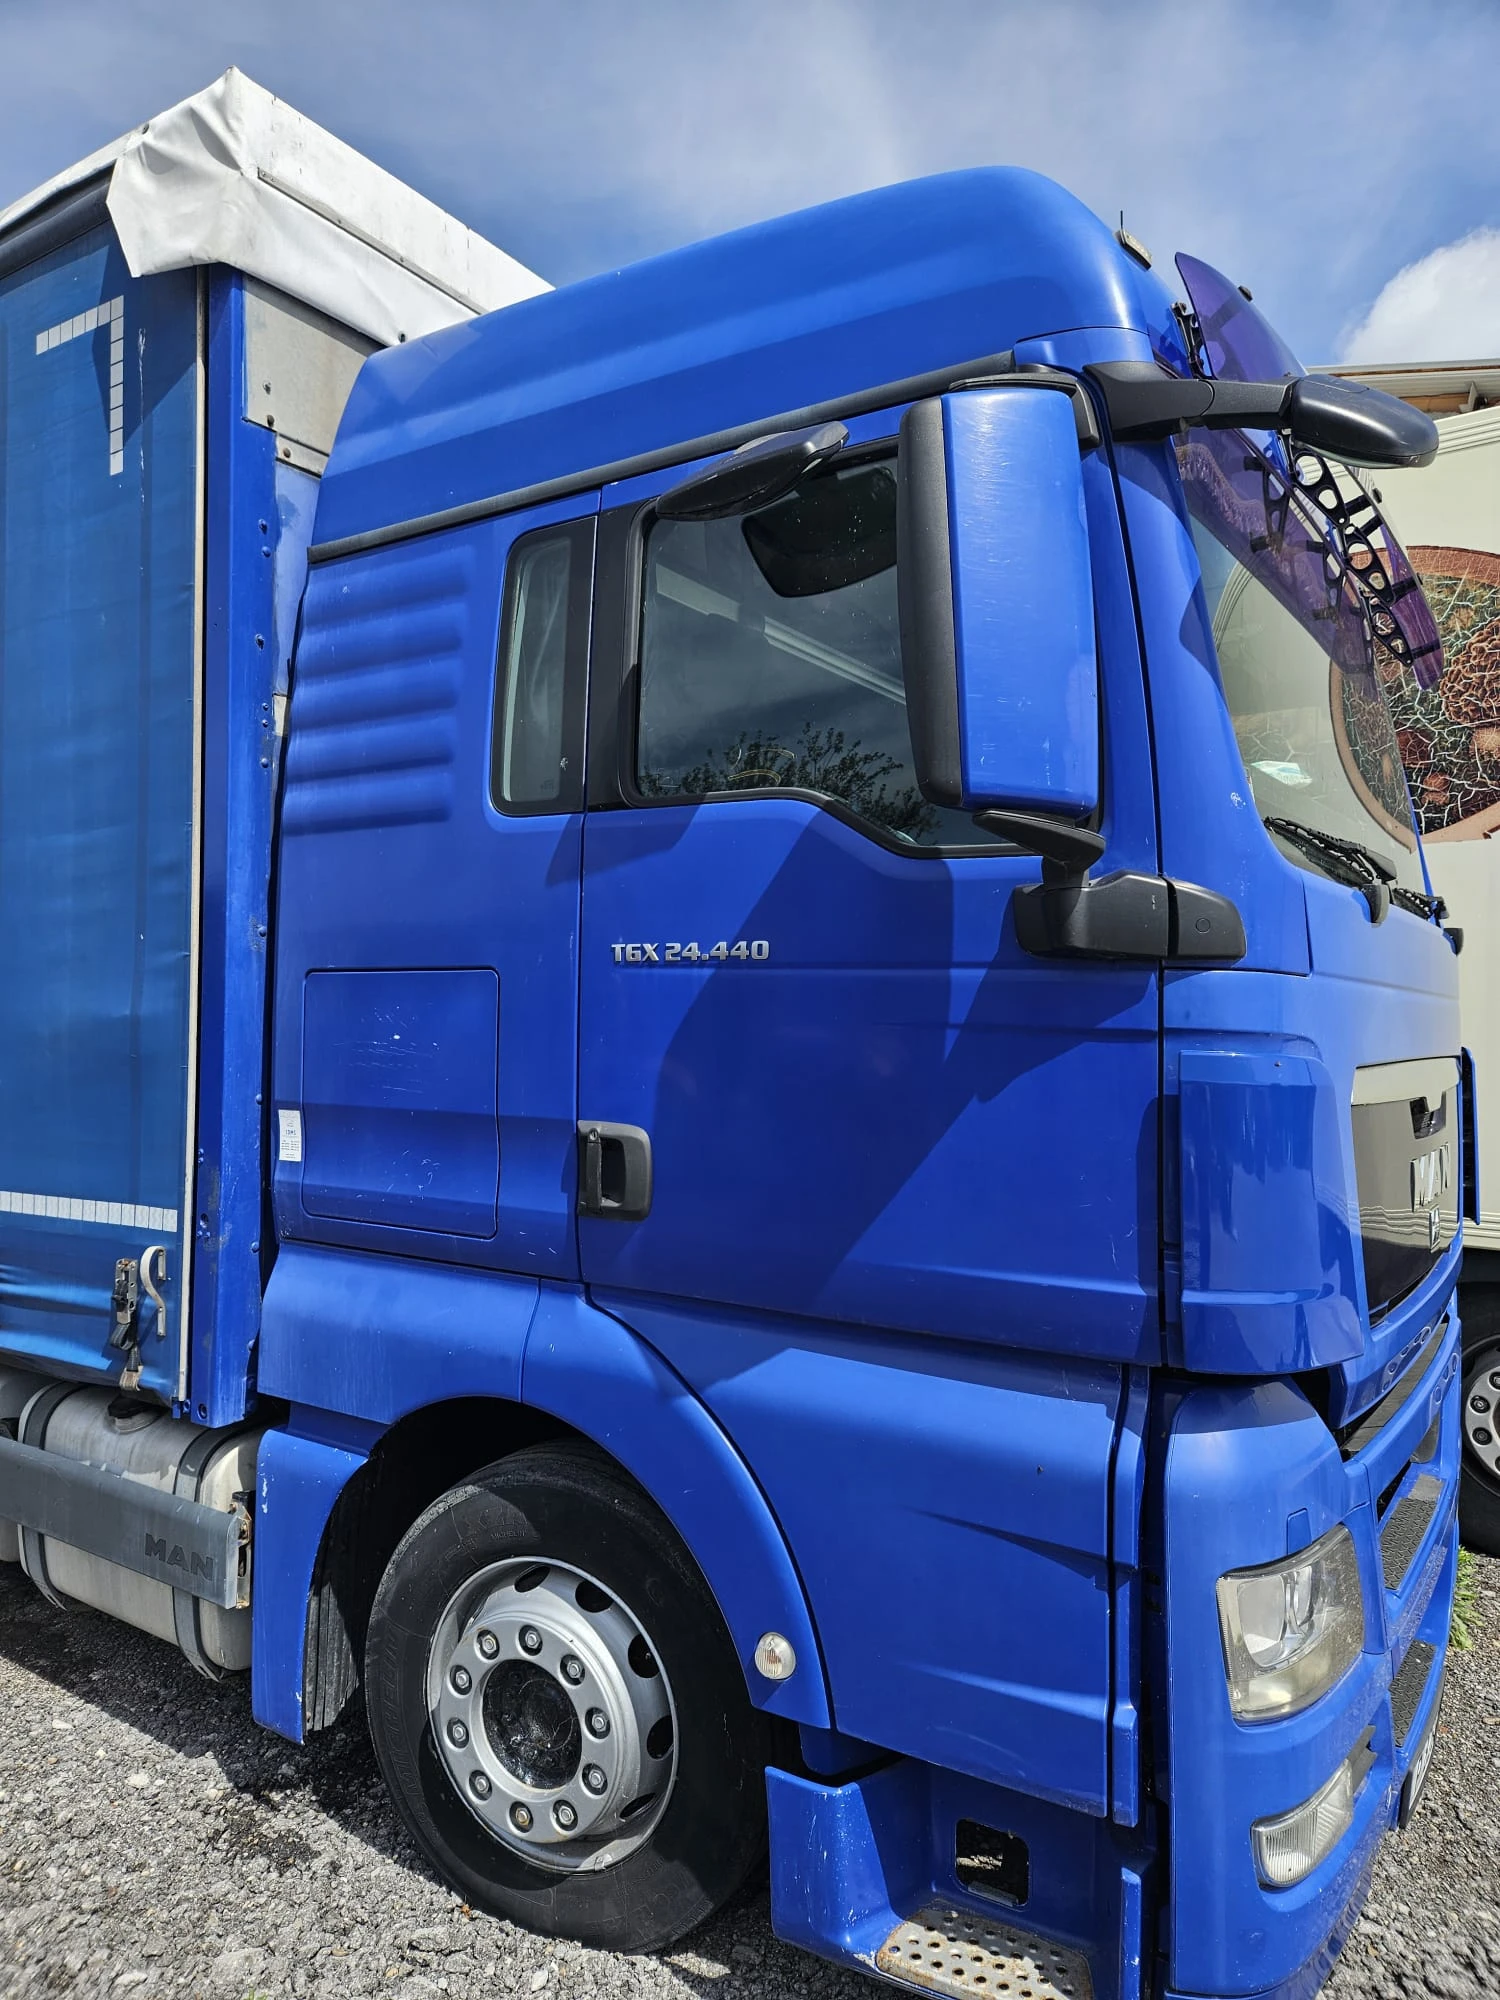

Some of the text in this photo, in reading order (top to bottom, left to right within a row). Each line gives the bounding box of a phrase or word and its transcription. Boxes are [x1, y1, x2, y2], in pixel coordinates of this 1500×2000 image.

[611, 940, 770, 962] TGX 24.440
[145, 1533, 214, 1581] MAN
